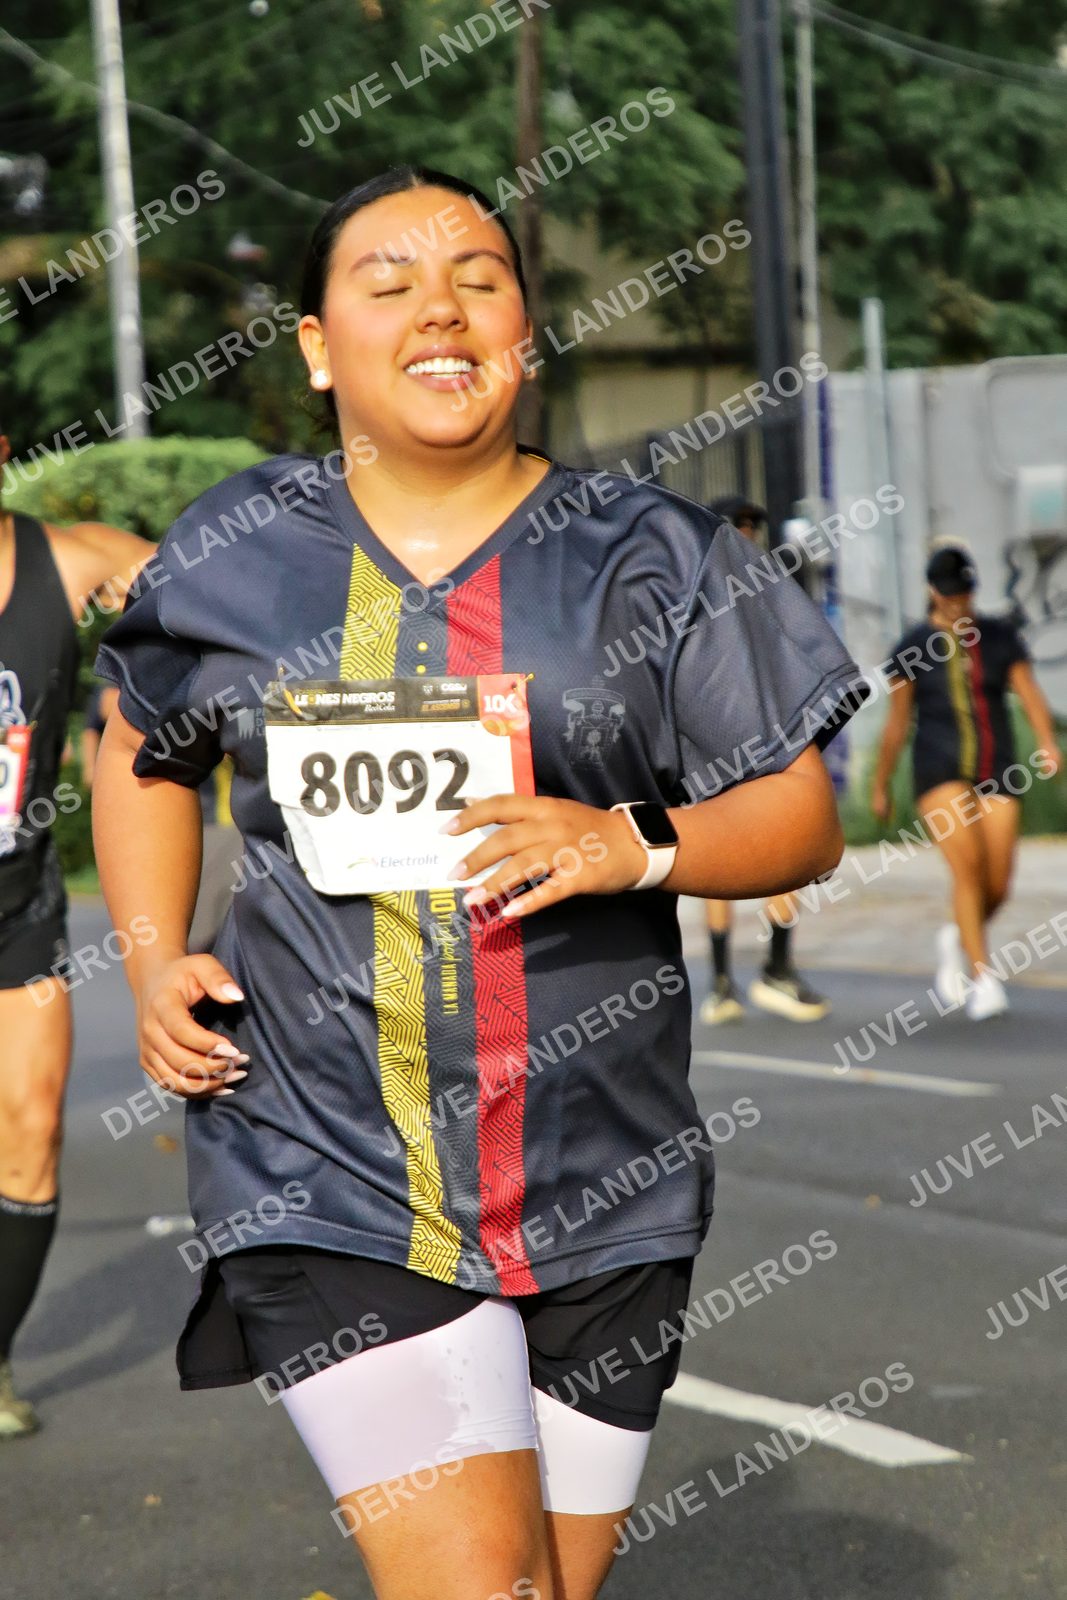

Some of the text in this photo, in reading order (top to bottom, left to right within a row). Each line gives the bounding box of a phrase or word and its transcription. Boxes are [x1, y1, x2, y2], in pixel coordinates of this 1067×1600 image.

[342, 691, 395, 704] NEGROS
[300, 748, 470, 817] 8092
[437, 914, 453, 925] LA
[440, 963, 459, 1001] MANADA
[442, 1003, 459, 1015] LA
